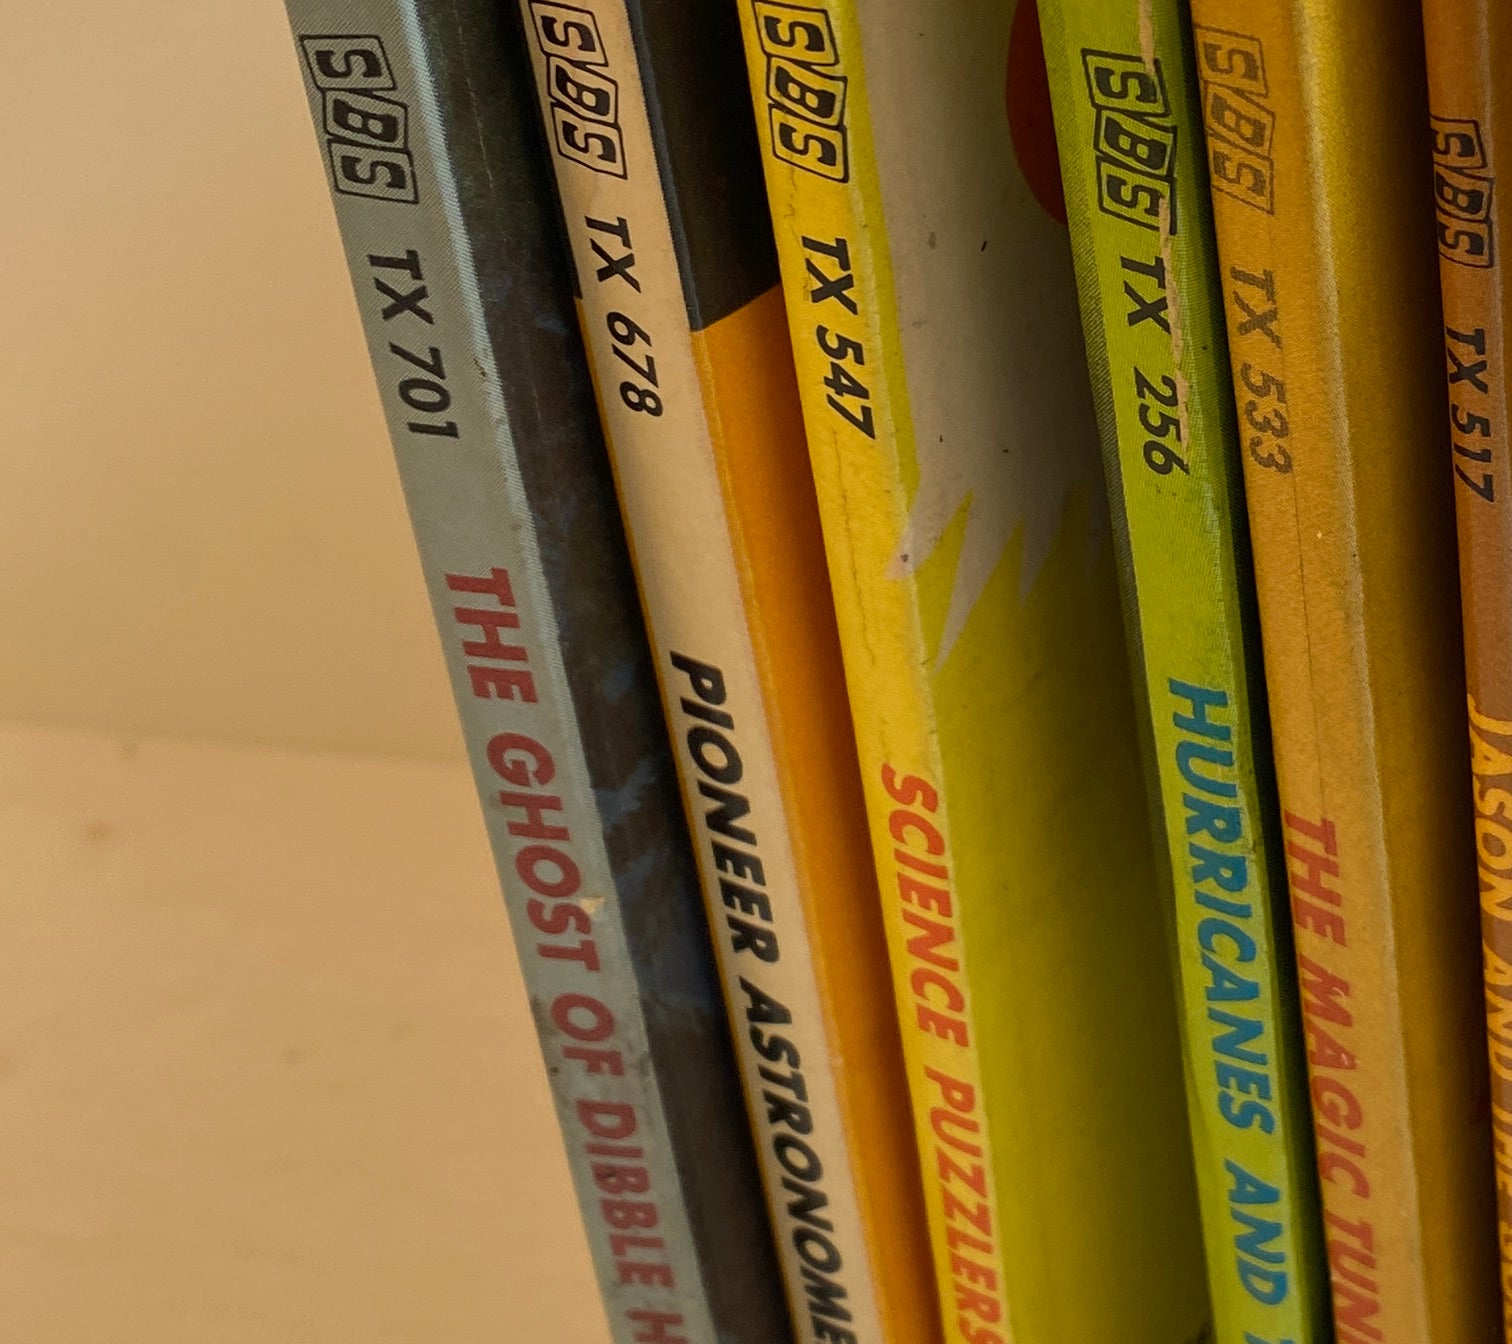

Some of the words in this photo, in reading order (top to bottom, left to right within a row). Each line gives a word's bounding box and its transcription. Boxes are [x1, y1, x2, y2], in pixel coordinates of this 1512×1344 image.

[369, 249, 436, 324] TX
[583, 215, 643, 295] TX
[801, 235, 859, 316] TX
[1120, 254, 1173, 337] TX
[1230, 266, 1283, 350] TX
[390, 345, 459, 439] 701
[606, 309, 665, 418] 678
[817, 327, 877, 441] 547
[1446, 327, 1489, 393] TX
[1133, 366, 1190, 477] 256
[1239, 362, 1292, 474] 533
[1450, 411, 1495, 503] 517
[444, 567, 539, 704] THE
[485, 732, 602, 972] GHOST
[669, 649, 780, 965] PIONEER
[880, 762, 970, 1050] SCIENCE
[1166, 677, 1276, 1135] HURRICANES
[1283, 808, 1345, 946] THE
[549, 994, 626, 1078] OF
[1299, 957, 1370, 1201] MAGIC
[576, 1099, 676, 1289] DIBBLE
[1225, 1158, 1289, 1306] AND
